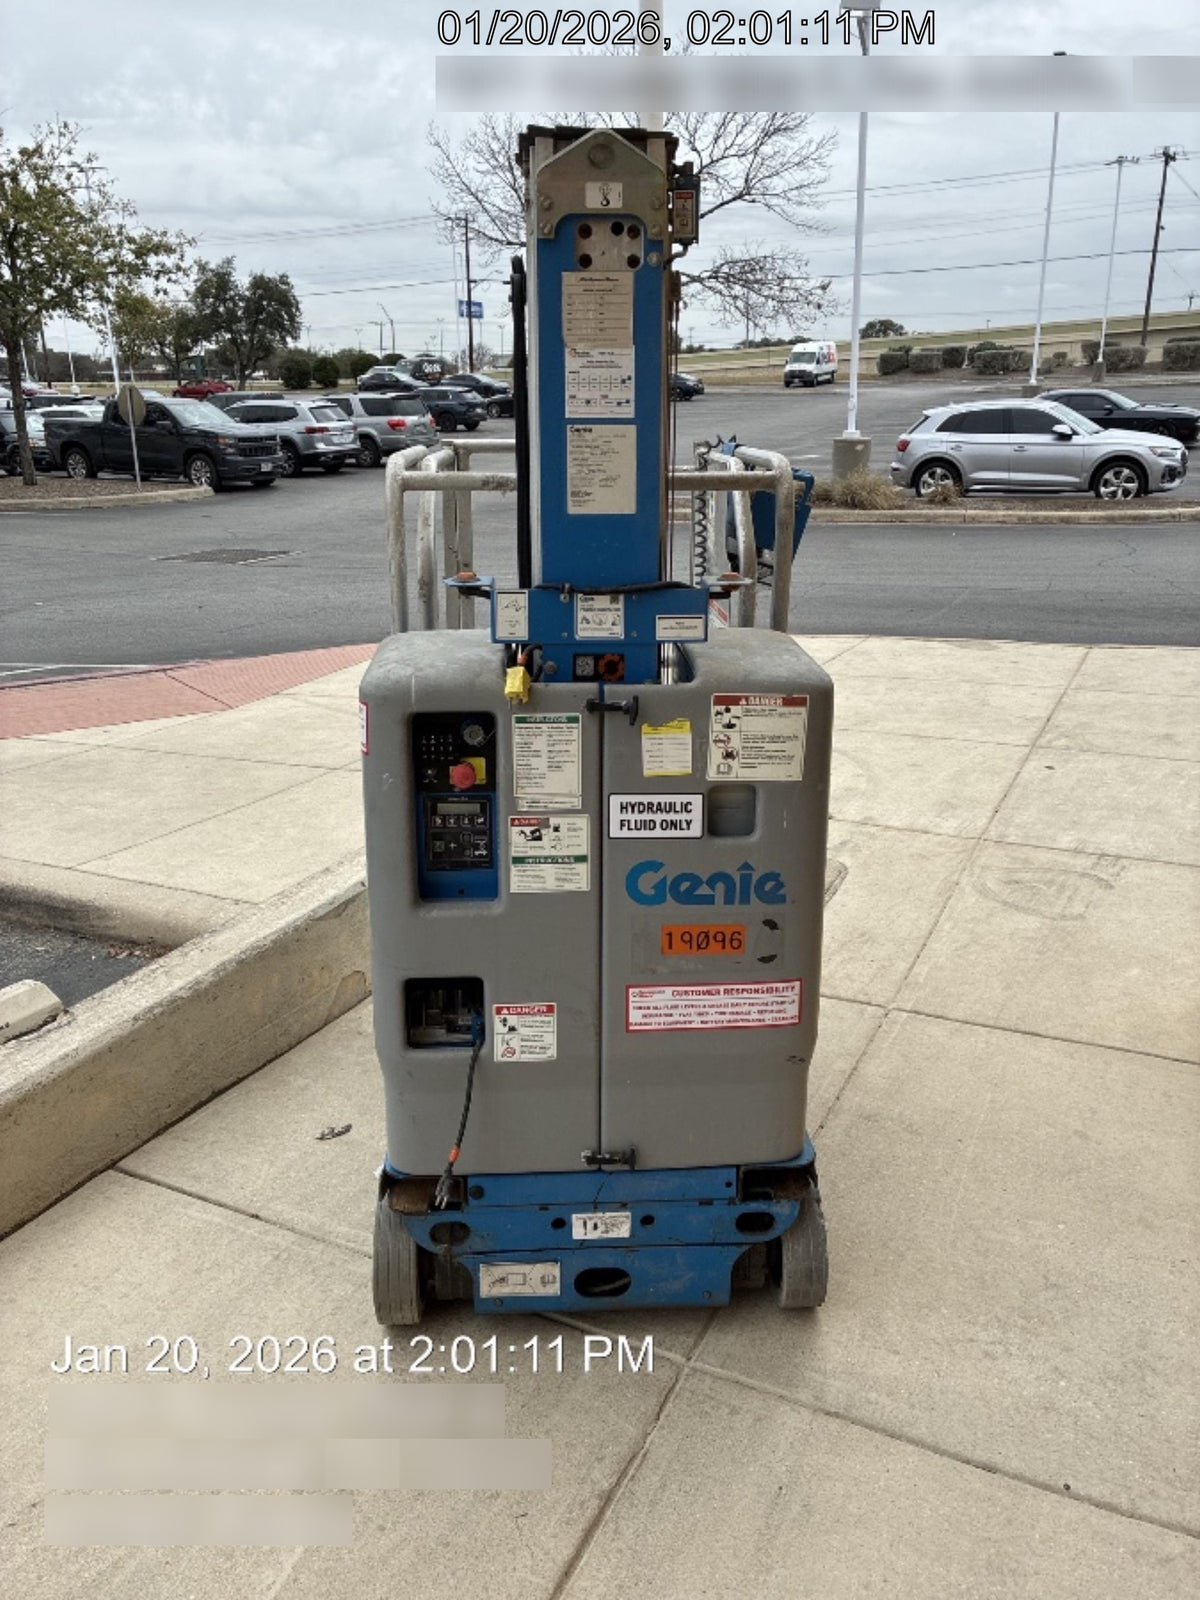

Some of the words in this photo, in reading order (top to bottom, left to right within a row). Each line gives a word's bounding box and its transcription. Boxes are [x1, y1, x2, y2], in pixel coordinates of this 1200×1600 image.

[619, 801, 693, 815] HYDRAULIC
[619, 819, 657, 831] FLUID
[660, 819, 693, 831] ONLY
[625, 860, 788, 906] Genie
[671, 988, 721, 998] CUSTOMER
[723, 985, 796, 996] RESPONSIBILITY
